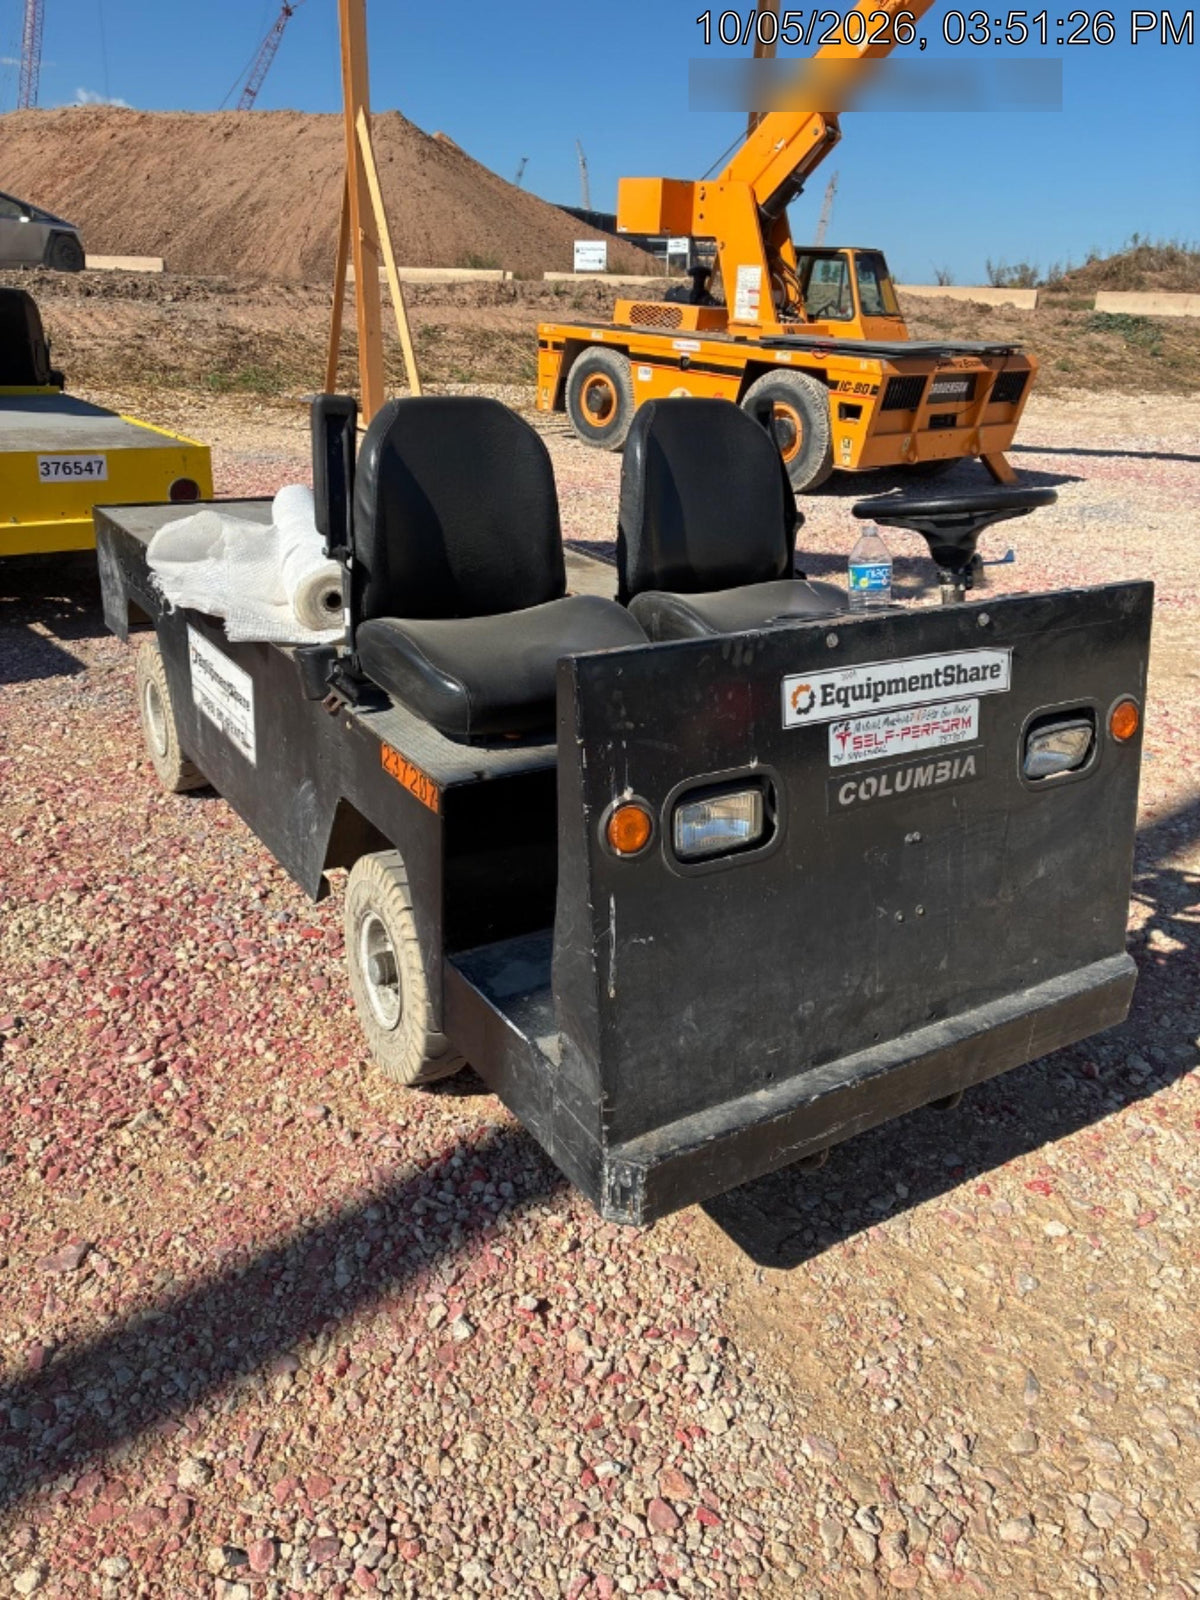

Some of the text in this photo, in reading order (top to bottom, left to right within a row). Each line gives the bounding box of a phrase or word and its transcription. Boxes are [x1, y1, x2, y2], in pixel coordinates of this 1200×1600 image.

[838, 380, 870, 395] IC-80
[40, 460, 104, 476] 376547
[820, 662, 1002, 708] EquipmentShare
[852, 716, 972, 750] SELF-PERFORM
[384, 744, 438, 808] 237207
[838, 755, 976, 805] COLUMBIA
